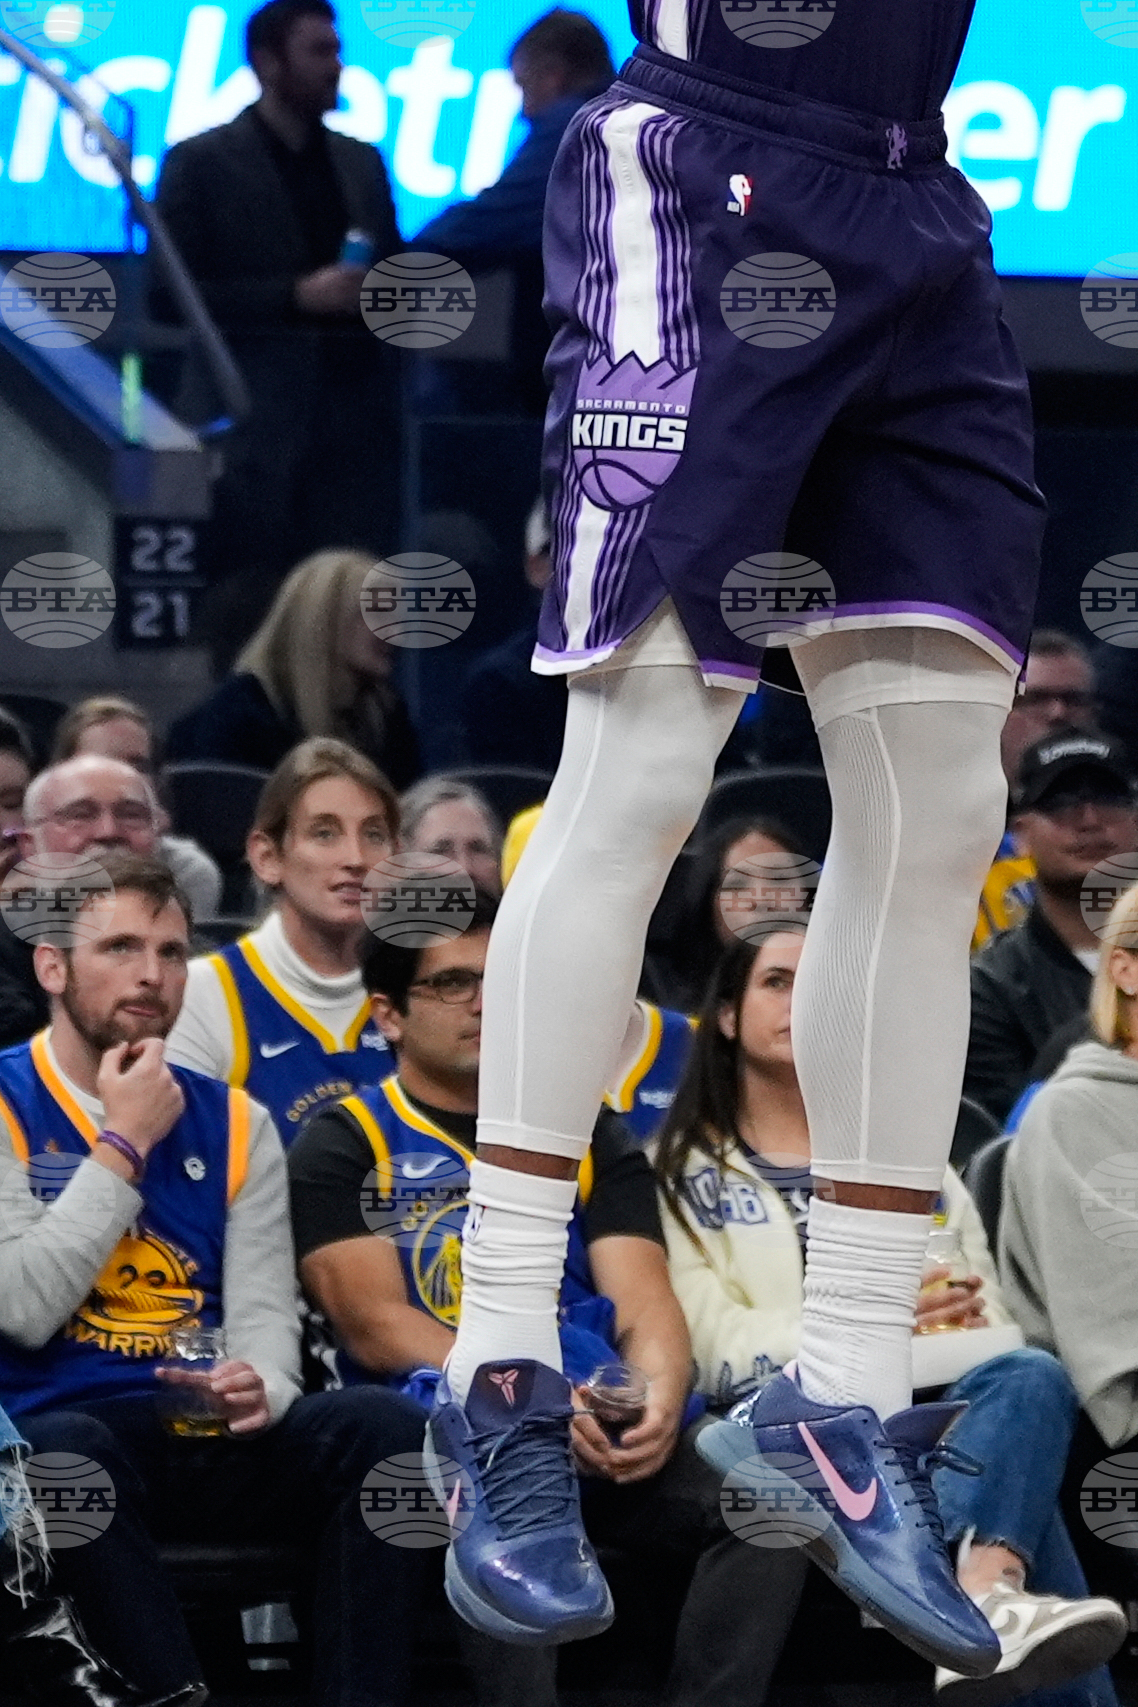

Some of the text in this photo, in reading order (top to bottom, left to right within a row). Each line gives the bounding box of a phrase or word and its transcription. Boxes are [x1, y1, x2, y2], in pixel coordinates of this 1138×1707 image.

[577, 398, 687, 415] SACRAMENTO
[572, 413, 688, 451] KINGS
[131, 525, 196, 573] 22
[131, 592, 191, 639] 21
